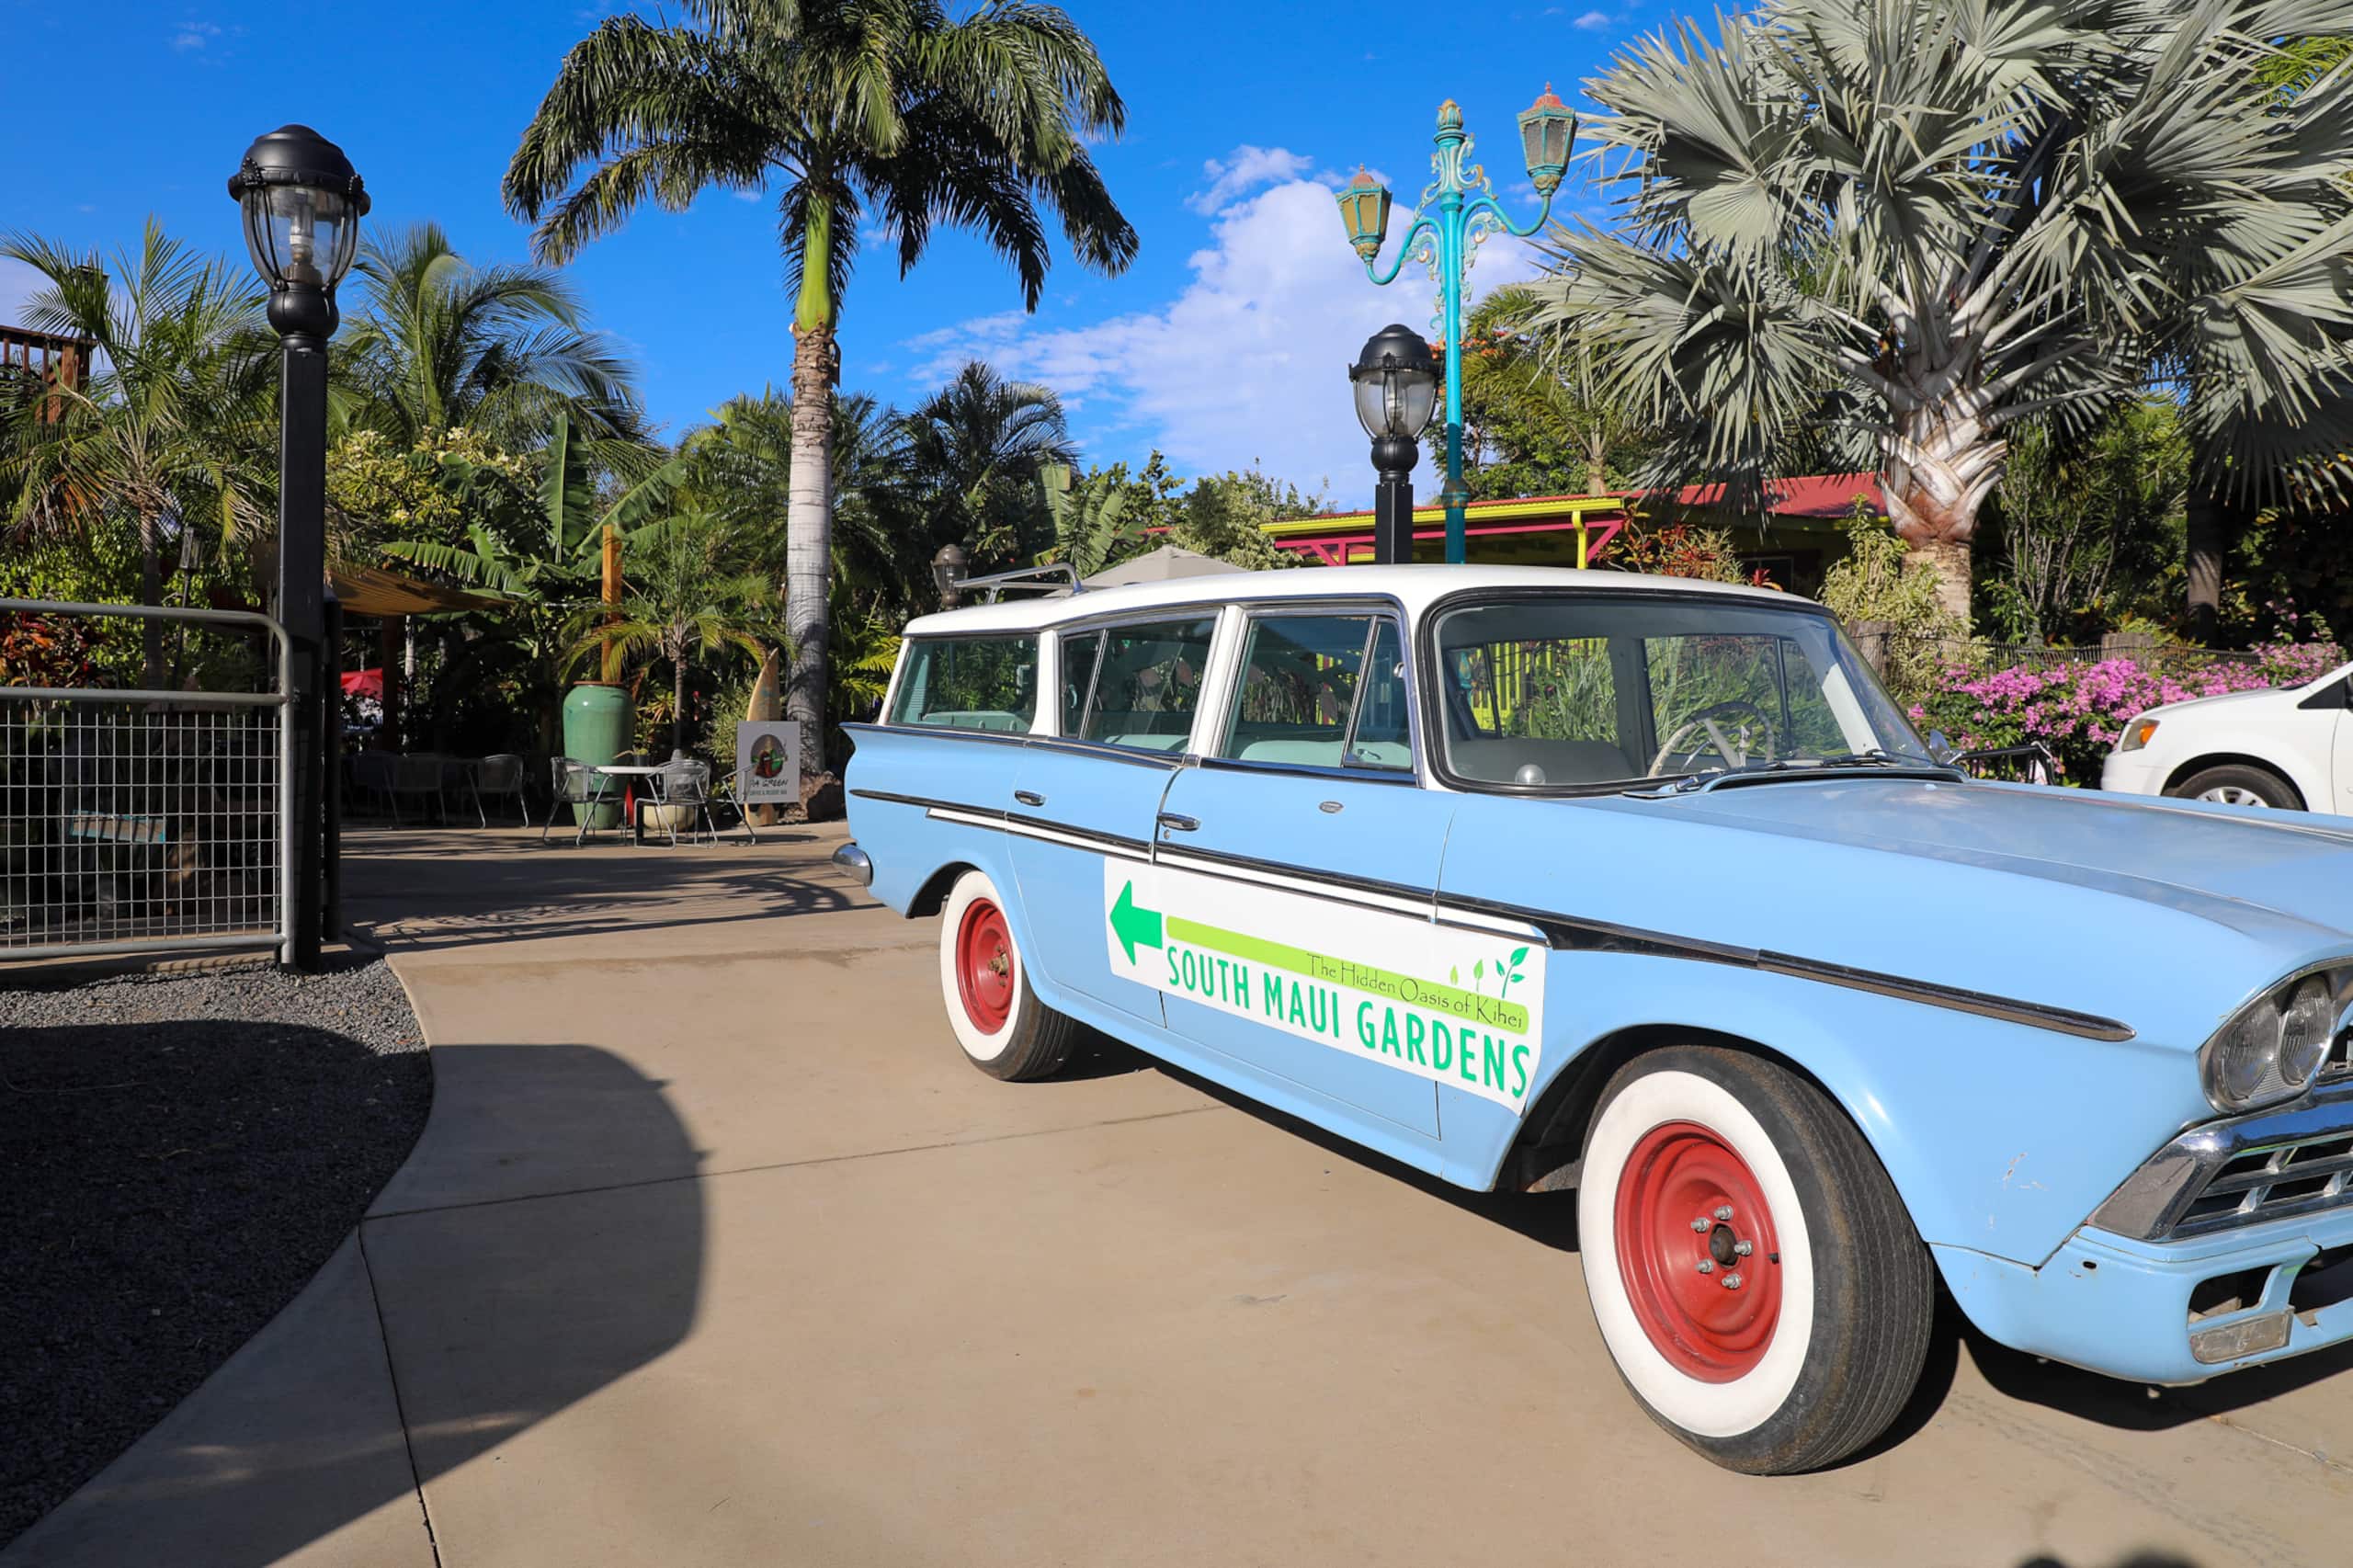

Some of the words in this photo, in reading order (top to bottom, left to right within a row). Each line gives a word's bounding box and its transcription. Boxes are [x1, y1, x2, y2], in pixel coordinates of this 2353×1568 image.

[1167, 946, 1250, 1009] SOUTH
[1263, 971, 1339, 1038] MAUI
[1357, 1001, 1529, 1098] GARDENS
[1307, 952, 1336, 979] The
[1341, 960, 1396, 994] Hidden
[1400, 977, 1449, 1009] Oasis
[1453, 994, 1471, 1014] of
[1476, 995, 1522, 1028] Kihei
